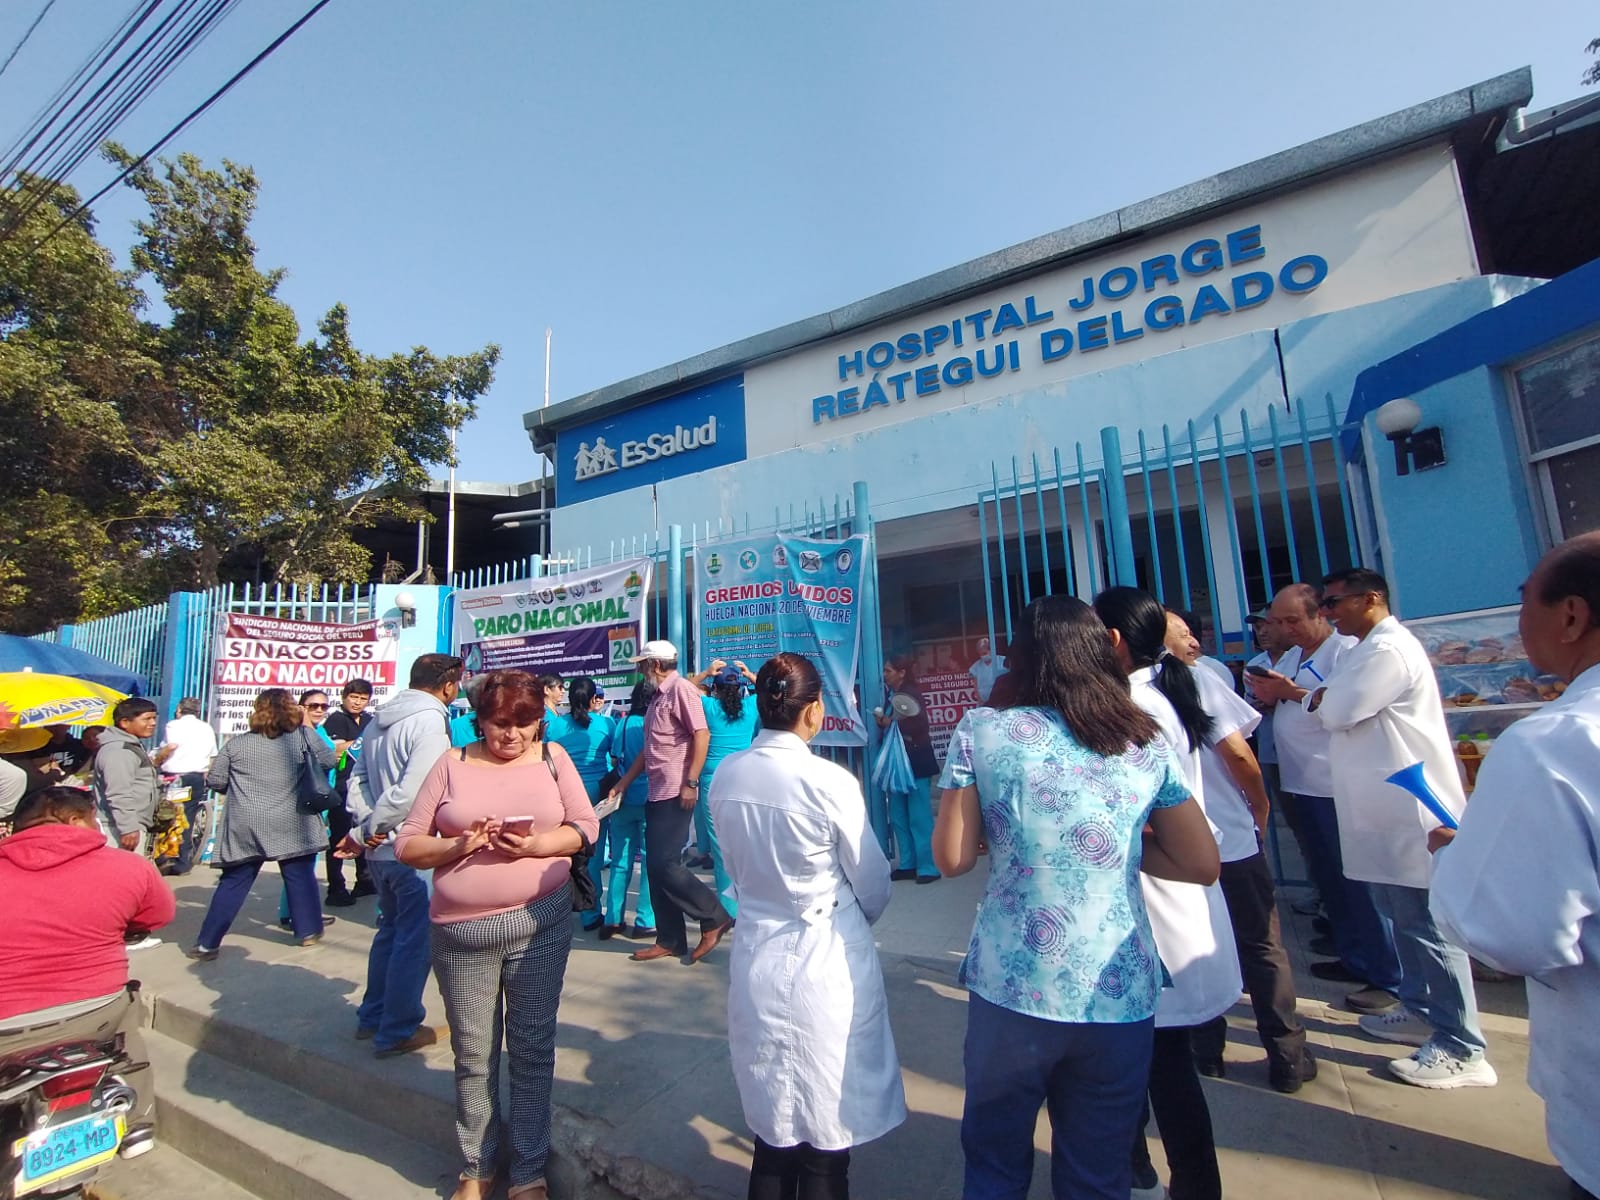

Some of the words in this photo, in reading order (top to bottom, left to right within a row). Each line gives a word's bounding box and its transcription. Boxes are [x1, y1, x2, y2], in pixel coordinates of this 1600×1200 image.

[838, 296, 1053, 381] HOSPITAL
[1069, 224, 1265, 311] JORGE
[812, 340, 1020, 424] REÁTEGUI
[1040, 254, 1328, 363] DELGADO
[621, 415, 717, 468] EsSalud
[705, 580, 783, 604] GREMIOS
[473, 612, 522, 638] PARO
[524, 596, 630, 632] NACIONAL
[705, 603, 735, 620] HUELGA
[738, 601, 776, 617] NACIONA
[805, 604, 851, 623] VIEMBRE
[233, 617, 279, 630] SINDICATO
[280, 621, 322, 633] NACIONAL
[246, 628, 262, 637] DEL
[296, 631, 325, 641] SOCIAL
[228, 641, 374, 660] SINACOBSS
[613, 640, 634, 660] 20
[216, 662, 271, 684] PARO
[277, 662, 386, 684] NACIONAL
[822, 716, 855, 732] IDOS!
[927, 707, 957, 723] ARO
